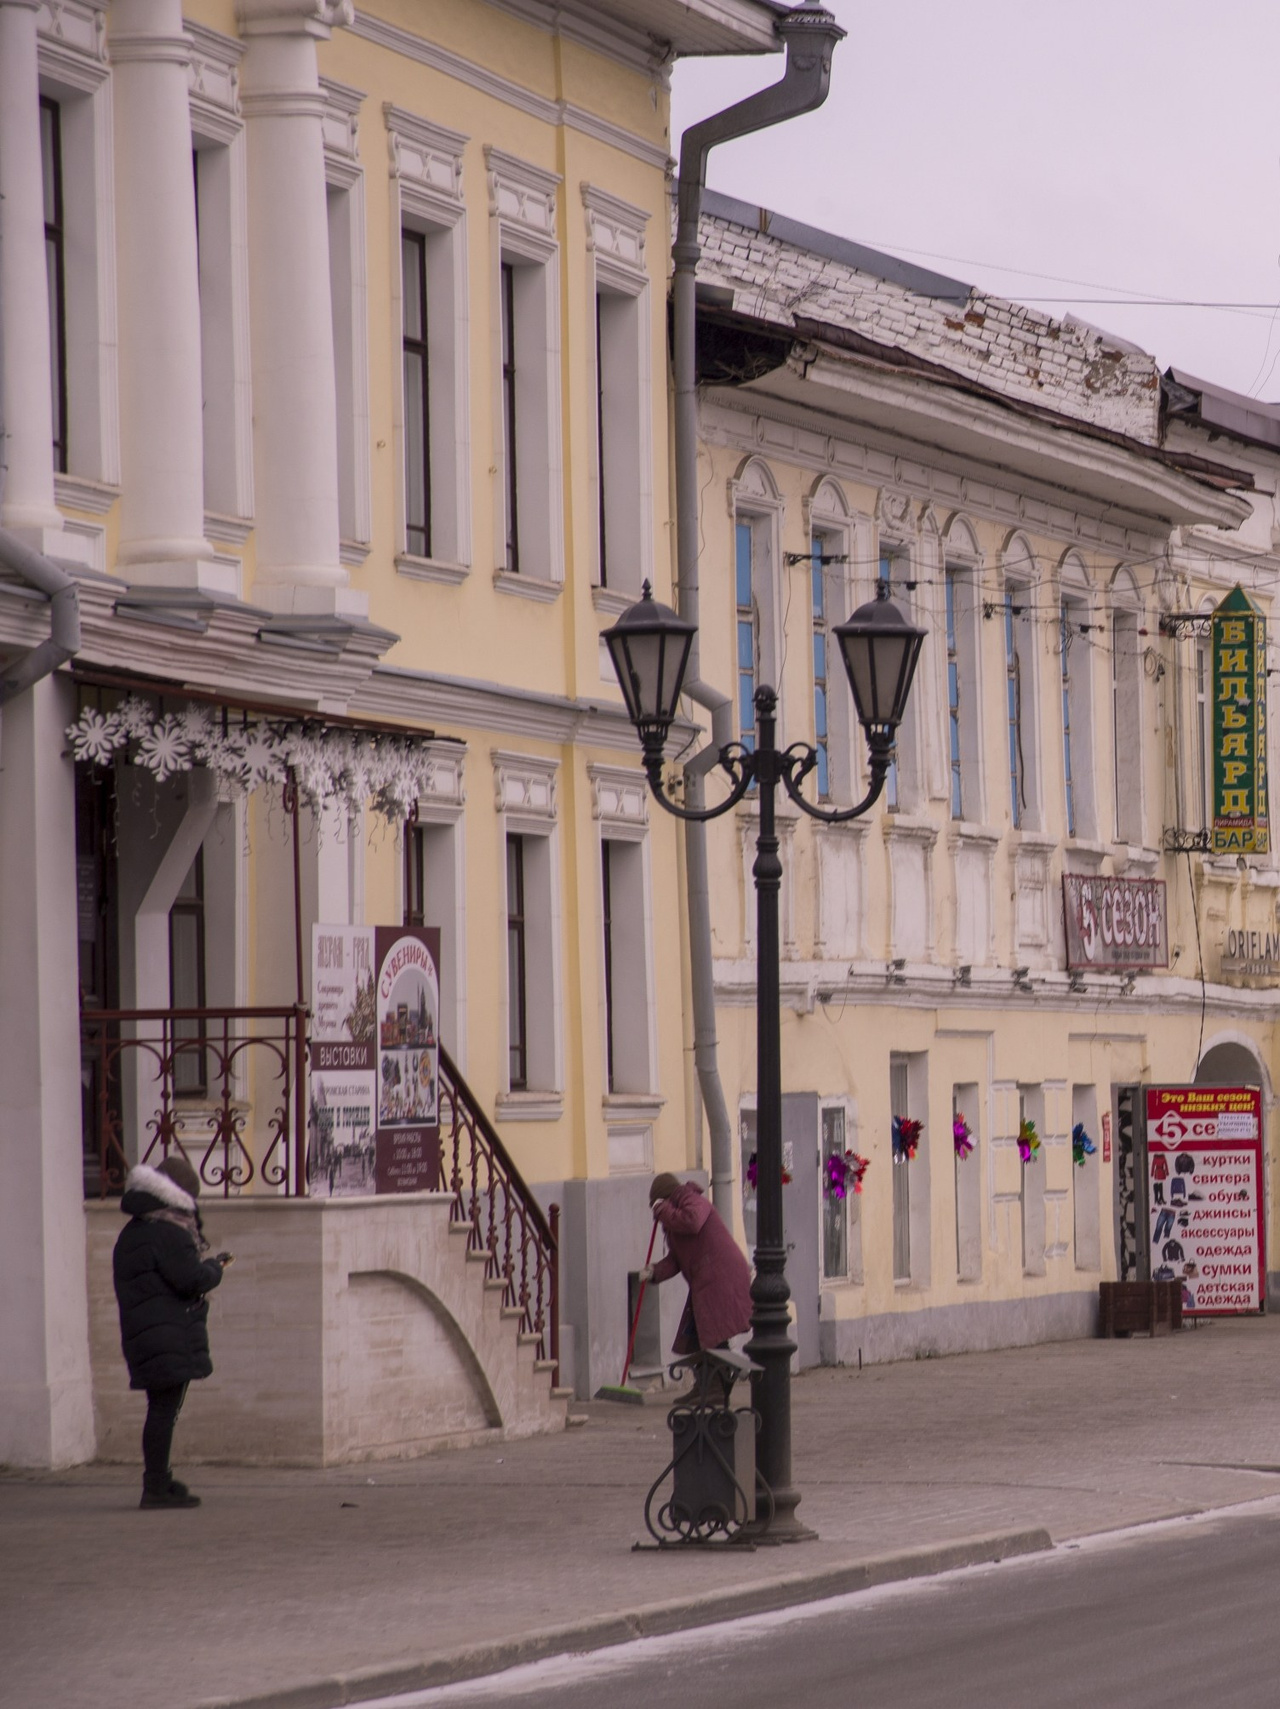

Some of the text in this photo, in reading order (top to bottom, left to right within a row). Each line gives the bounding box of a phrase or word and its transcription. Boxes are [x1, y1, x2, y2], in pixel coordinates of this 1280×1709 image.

[1218, 620, 1249, 816] БИЛЬЯРД
[1214, 818, 1253, 828] ПИРАМИДА
[1214, 831, 1253, 849] БАР
[1081, 883, 1095, 960] 5
[381, 945, 428, 999] СУВЕНИРЫ
[320, 1046, 368, 1066] ВЫСТАВКИ
[1161, 1091, 1251, 1103] Это Ваш сезон
[1179, 1100, 1255, 1112] низких цен!
[1203, 1155, 1250, 1168] куртки
[1192, 1173, 1250, 1186] свитера
[1208, 1189, 1250, 1204] обувь
[1193, 1208, 1251, 1221] джинсы
[1181, 1227, 1255, 1240] аксессуары
[1196, 1244, 1252, 1257] одежда
[1202, 1263, 1252, 1279] сумки
[1196, 1282, 1254, 1295] детская
[1197, 1294, 1251, 1306] одежда
